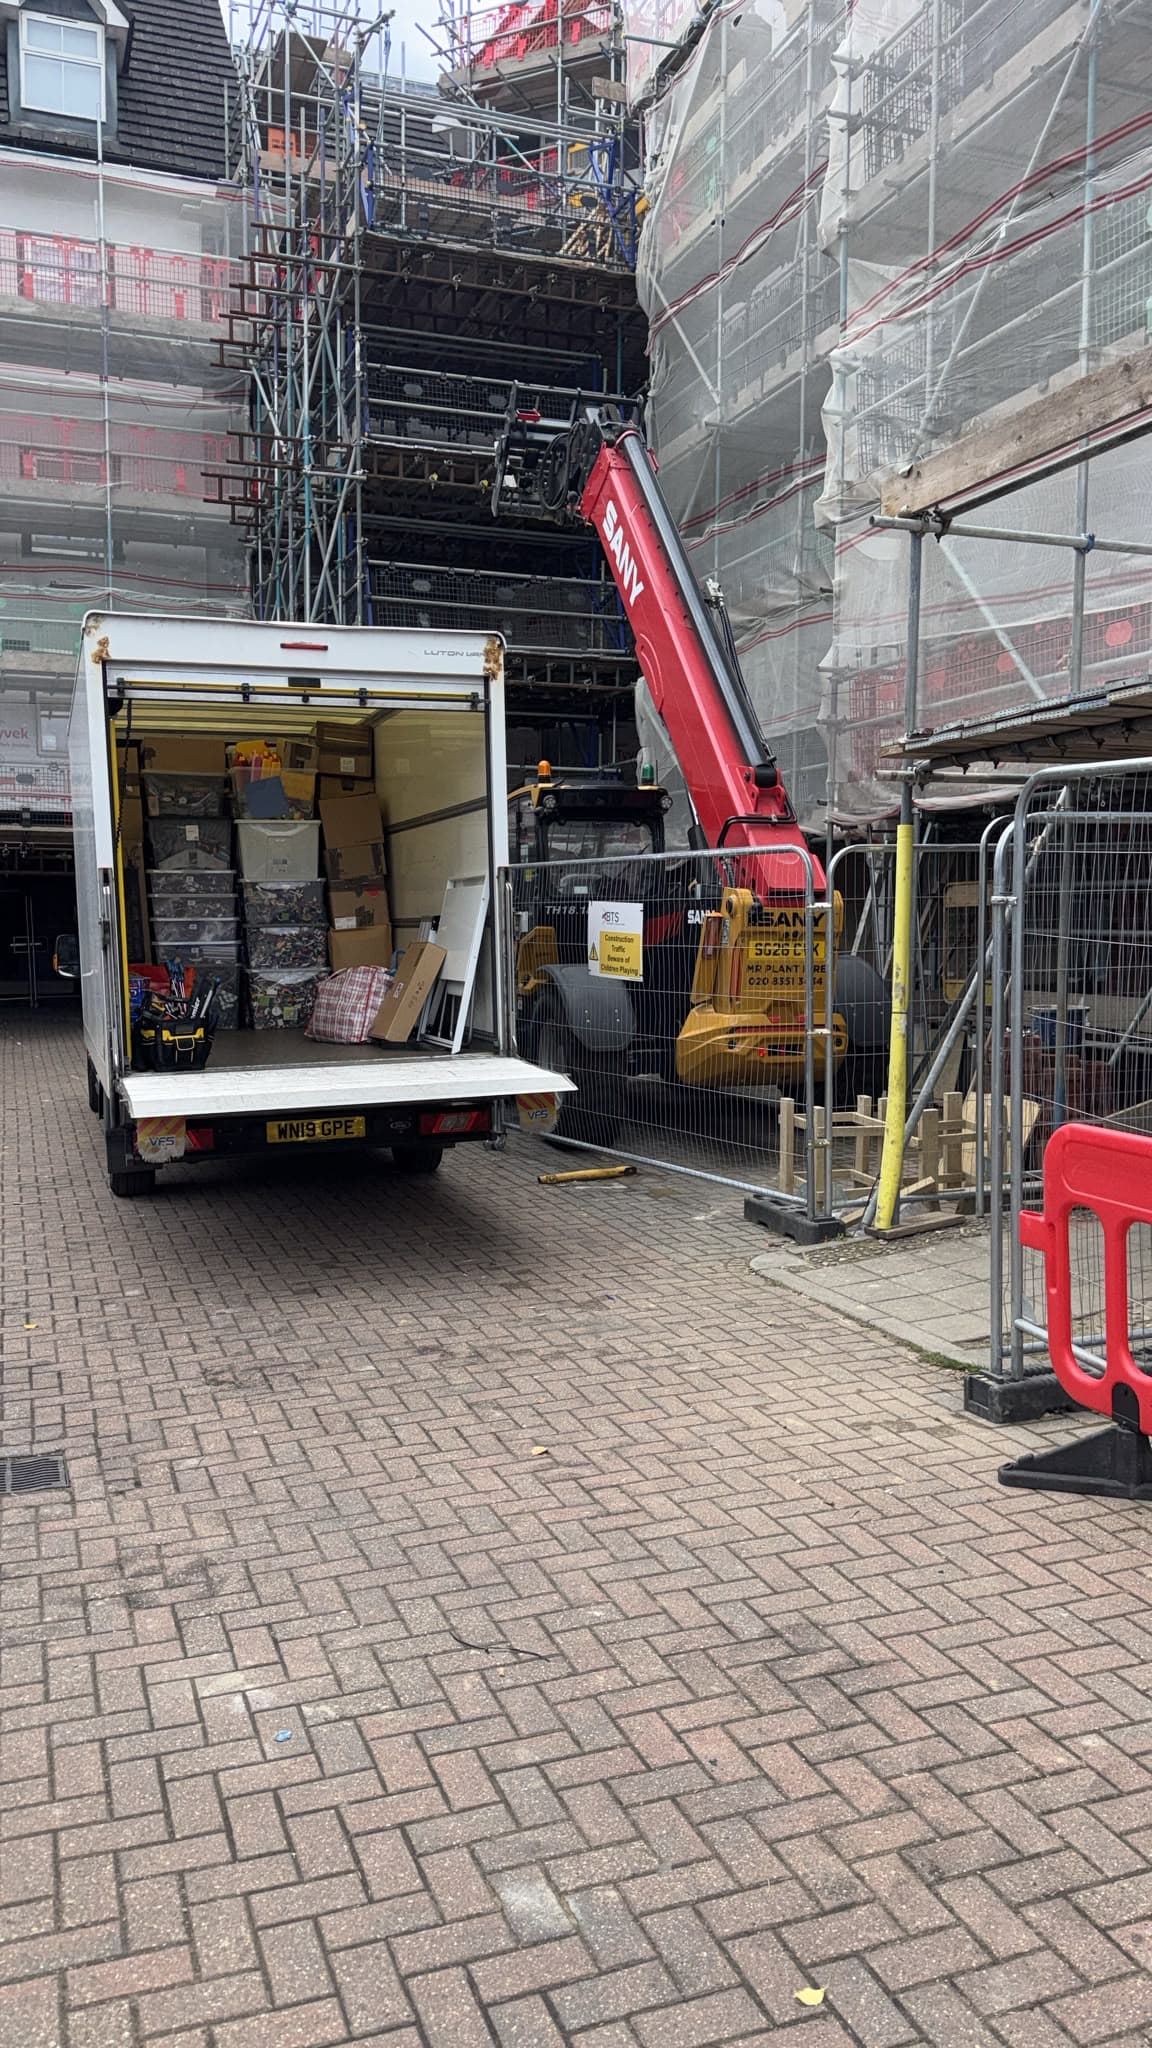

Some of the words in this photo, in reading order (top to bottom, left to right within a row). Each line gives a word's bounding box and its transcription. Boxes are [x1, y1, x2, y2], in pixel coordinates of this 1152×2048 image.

[602, 499, 645, 607] SANY
[544, 905, 589, 915] TH18.1
[604, 934, 634, 943] Construction
[611, 944, 626, 953] Traffic
[754, 942, 790, 956] SG26
[607, 955, 624, 963] Beware
[600, 964, 619, 973] Children
[620, 966, 639, 976] Playing
[747, 965, 762, 973] MR
[765, 965, 800, 973] PLANT
[803, 965, 827, 973] RE
[748, 977, 769, 986] 020
[772, 977, 795, 986] 8351
[527, 1110, 549, 1120] VFS
[278, 1122, 316, 1139] WN19
[321, 1120, 355, 1136] GPE
[148, 1136, 175, 1146] VFS
